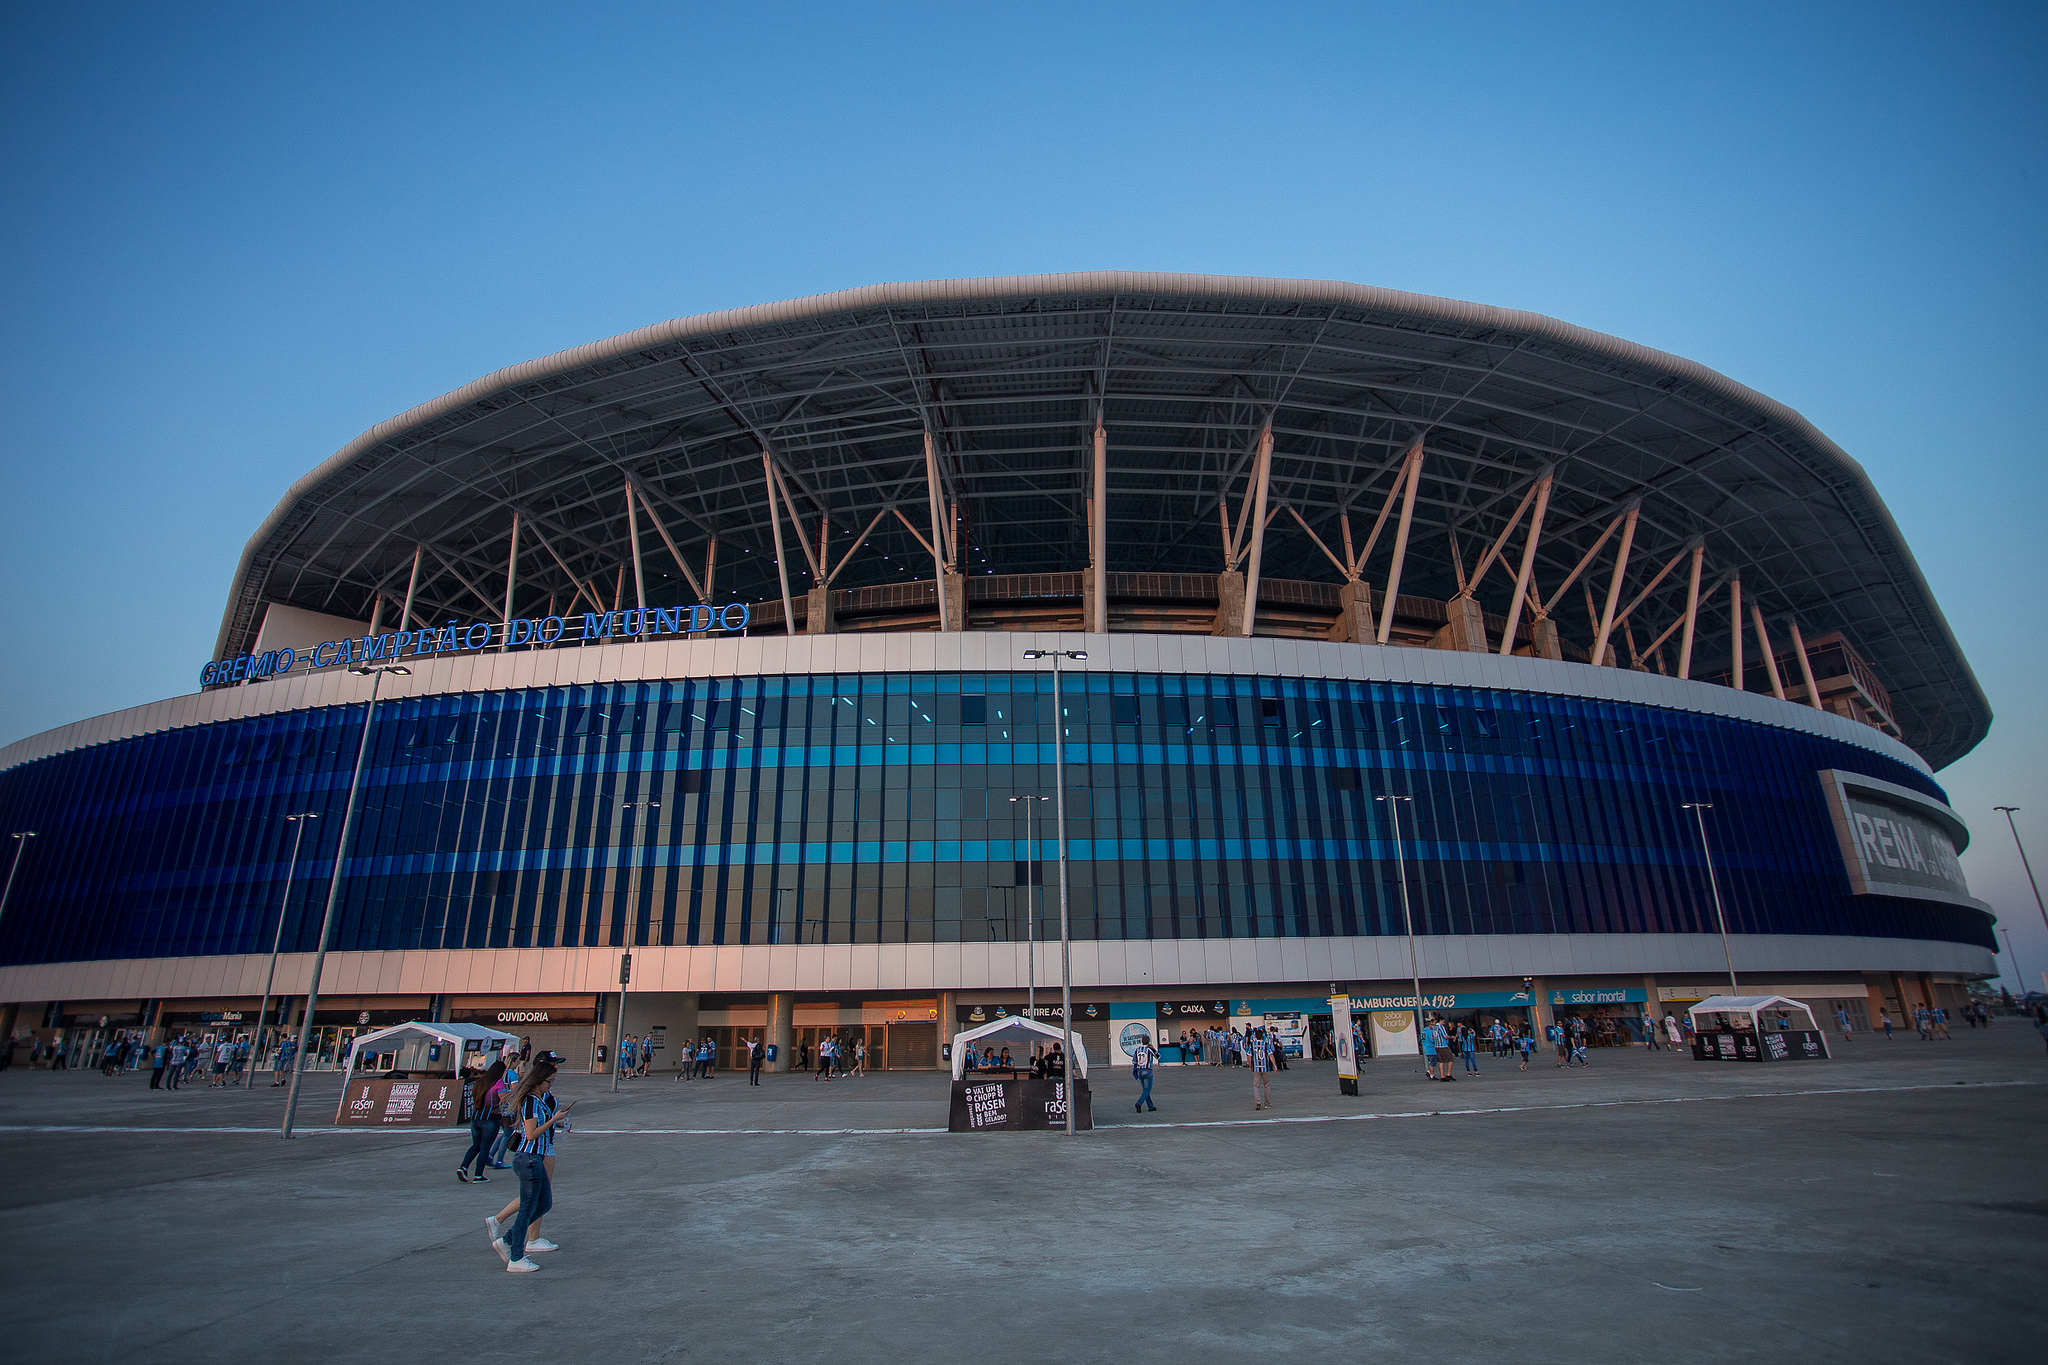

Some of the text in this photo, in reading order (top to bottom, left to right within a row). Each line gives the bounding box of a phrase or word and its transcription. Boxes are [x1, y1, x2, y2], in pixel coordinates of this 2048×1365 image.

[200, 648, 295, 687] GRÊMIO
[313, 619, 492, 668] CAMPEÃO
[506, 616, 565, 646] DO
[579, 603, 750, 640] MUNDO
[1571, 989, 1626, 1003] sabor imortal
[1432, 995, 1455, 1008] 1903
[929, 1009, 937, 1019] D
[1051, 1007, 1072, 1017] AQI
[1180, 1005, 1205, 1014] CAIXA
[497, 1012, 549, 1022] OUVIDORIA
[898, 1010, 906, 1020] D
[1384, 1012, 1402, 1020] sabor
[1382, 1018, 1407, 1027] imortal
[973, 1085, 996, 1095] VAI UM
[973, 1092, 997, 1102] CHOPP
[974, 1098, 1006, 1112] RASEN
[984, 1110, 998, 1118] BEM
[984, 1114, 1007, 1123] GELADO?
